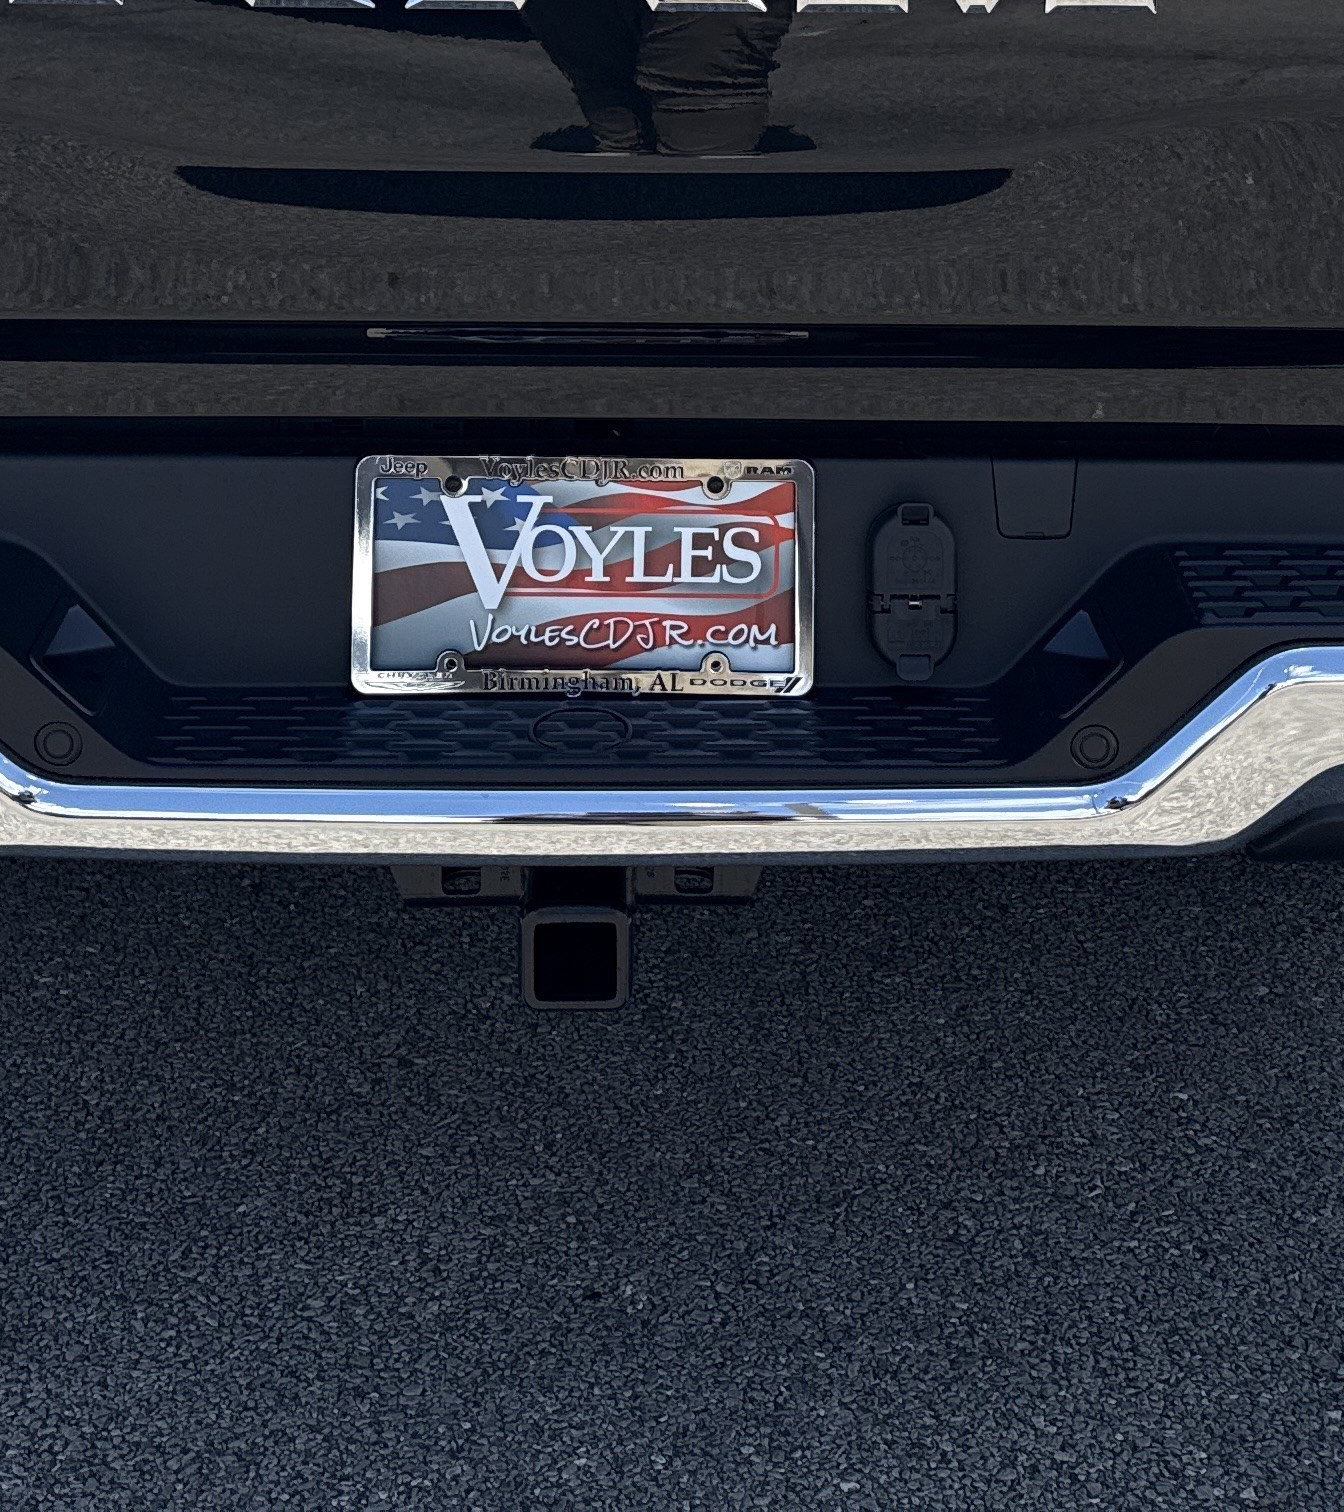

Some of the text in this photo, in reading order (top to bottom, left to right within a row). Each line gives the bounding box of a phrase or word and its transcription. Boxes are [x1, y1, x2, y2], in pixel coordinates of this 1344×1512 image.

[380, 456, 428, 478] Jeep
[480, 455, 685, 486] VoylesCDJR.com
[744, 465, 793, 476] RAM
[439, 494, 763, 610] VOYLES
[482, 668, 684, 697] Birmingham, AL
[689, 677, 787, 688] DODGE
